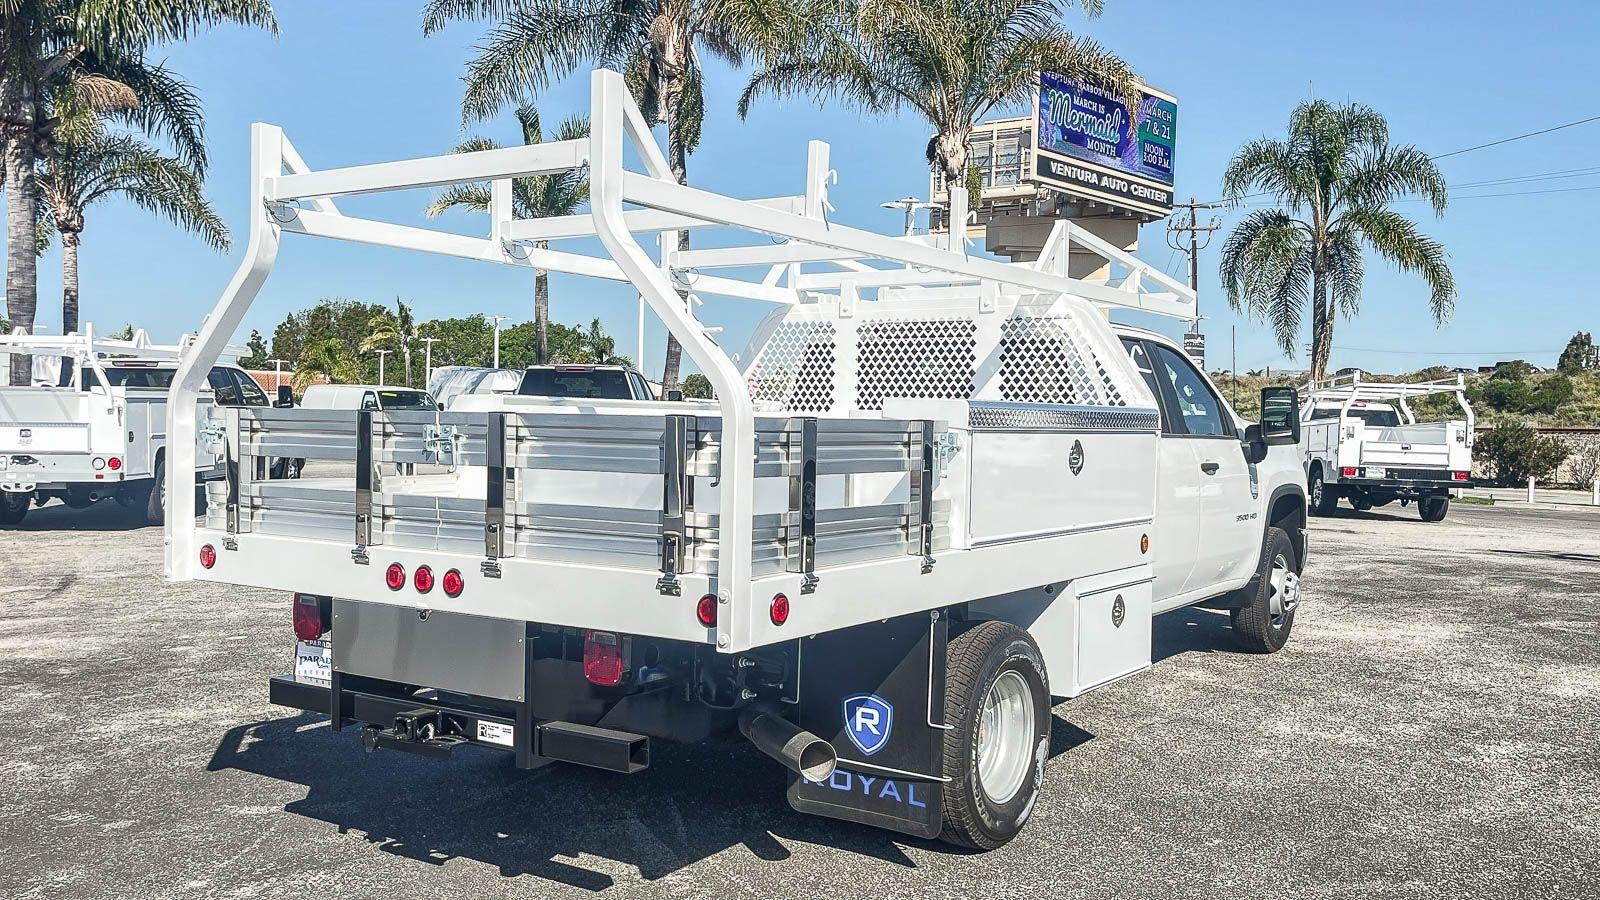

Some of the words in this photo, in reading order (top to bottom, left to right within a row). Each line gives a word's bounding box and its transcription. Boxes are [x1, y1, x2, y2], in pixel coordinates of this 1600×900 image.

[1073, 95, 1098, 112] MARCH
[1098, 103, 1105, 115] IS
[1145, 103, 1172, 123] MARCH
[1049, 88, 1121, 144] Mermaid
[1145, 118, 1152, 133] 7
[1152, 121, 1160, 136] &
[1161, 124, 1171, 140] 21
[1086, 138, 1116, 157] MONTH
[1144, 142, 1164, 158] NOON
[1143, 152, 1158, 164] 3:00
[1050, 161, 1099, 185] VENTURA
[1100, 175, 1128, 193] AUTO
[1130, 184, 1168, 204] CENTER
[1236, 513, 1249, 522] 3500
[855, 706, 881, 735] R
[802, 769, 926, 808] OYAL
